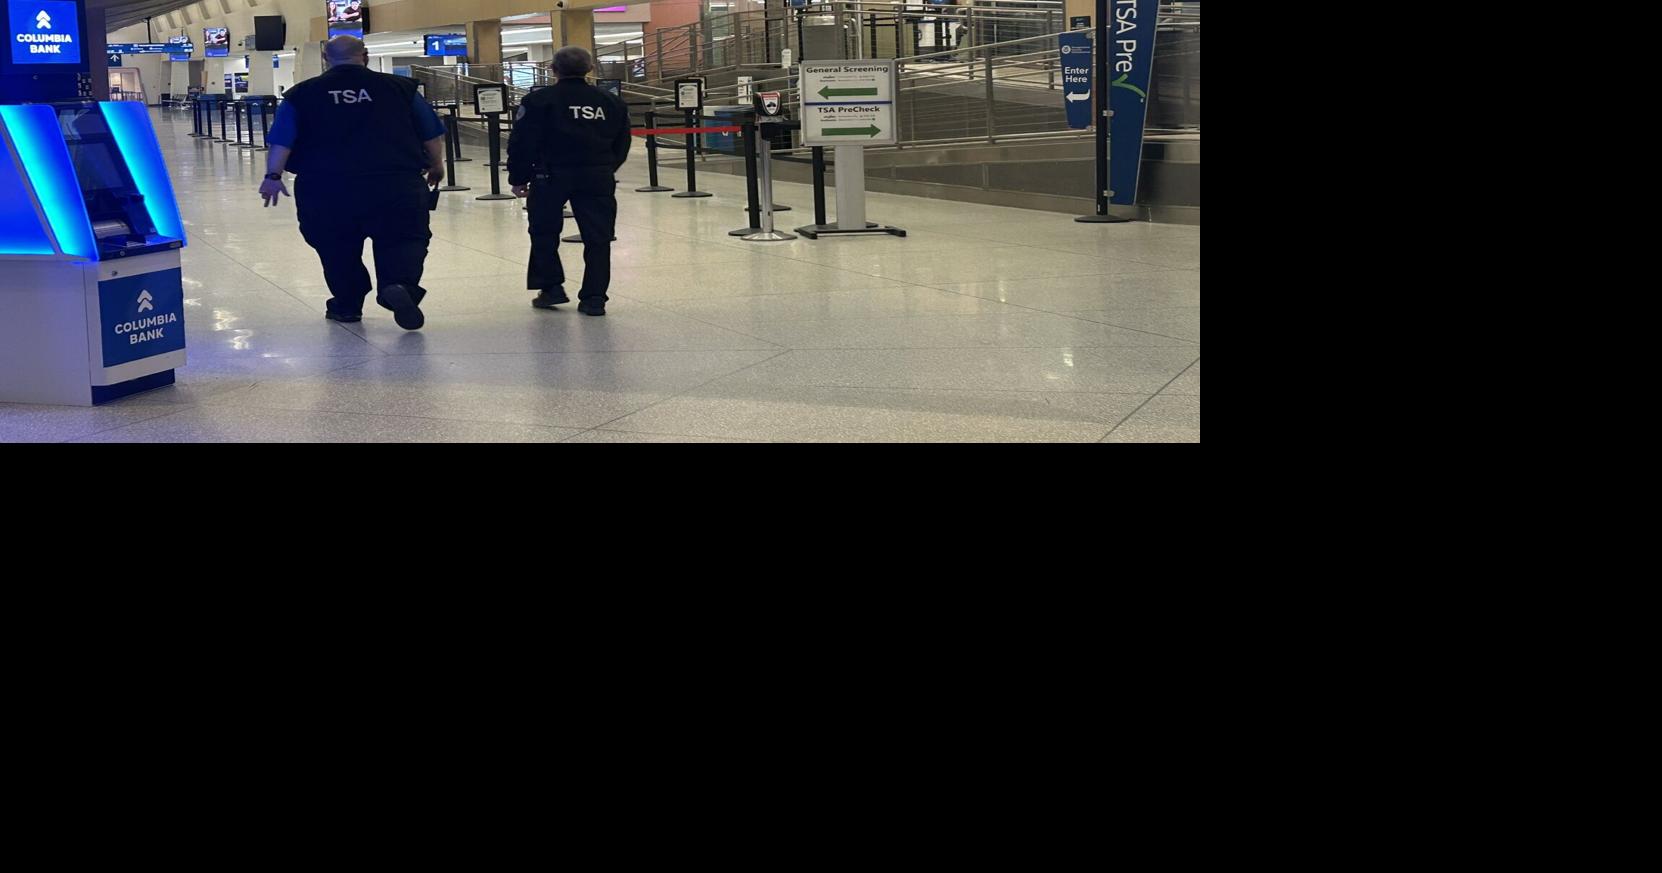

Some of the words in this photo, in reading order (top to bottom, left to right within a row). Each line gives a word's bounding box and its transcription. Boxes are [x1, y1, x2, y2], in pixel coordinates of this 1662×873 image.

[1115, 0, 1137, 34] TSA
[16, 33, 72, 43] COLUMBIA
[432, 41, 439, 50] 1
[29, 44, 61, 53] BANK
[1115, 40, 1137, 72] Pre
[843, 65, 889, 73] Screening
[1065, 75, 1088, 83] Here
[327, 88, 373, 104] TSA
[568, 105, 605, 120] TSA
[115, 313, 176, 334] COLUMBIA
[130, 328, 163, 344] BANK
